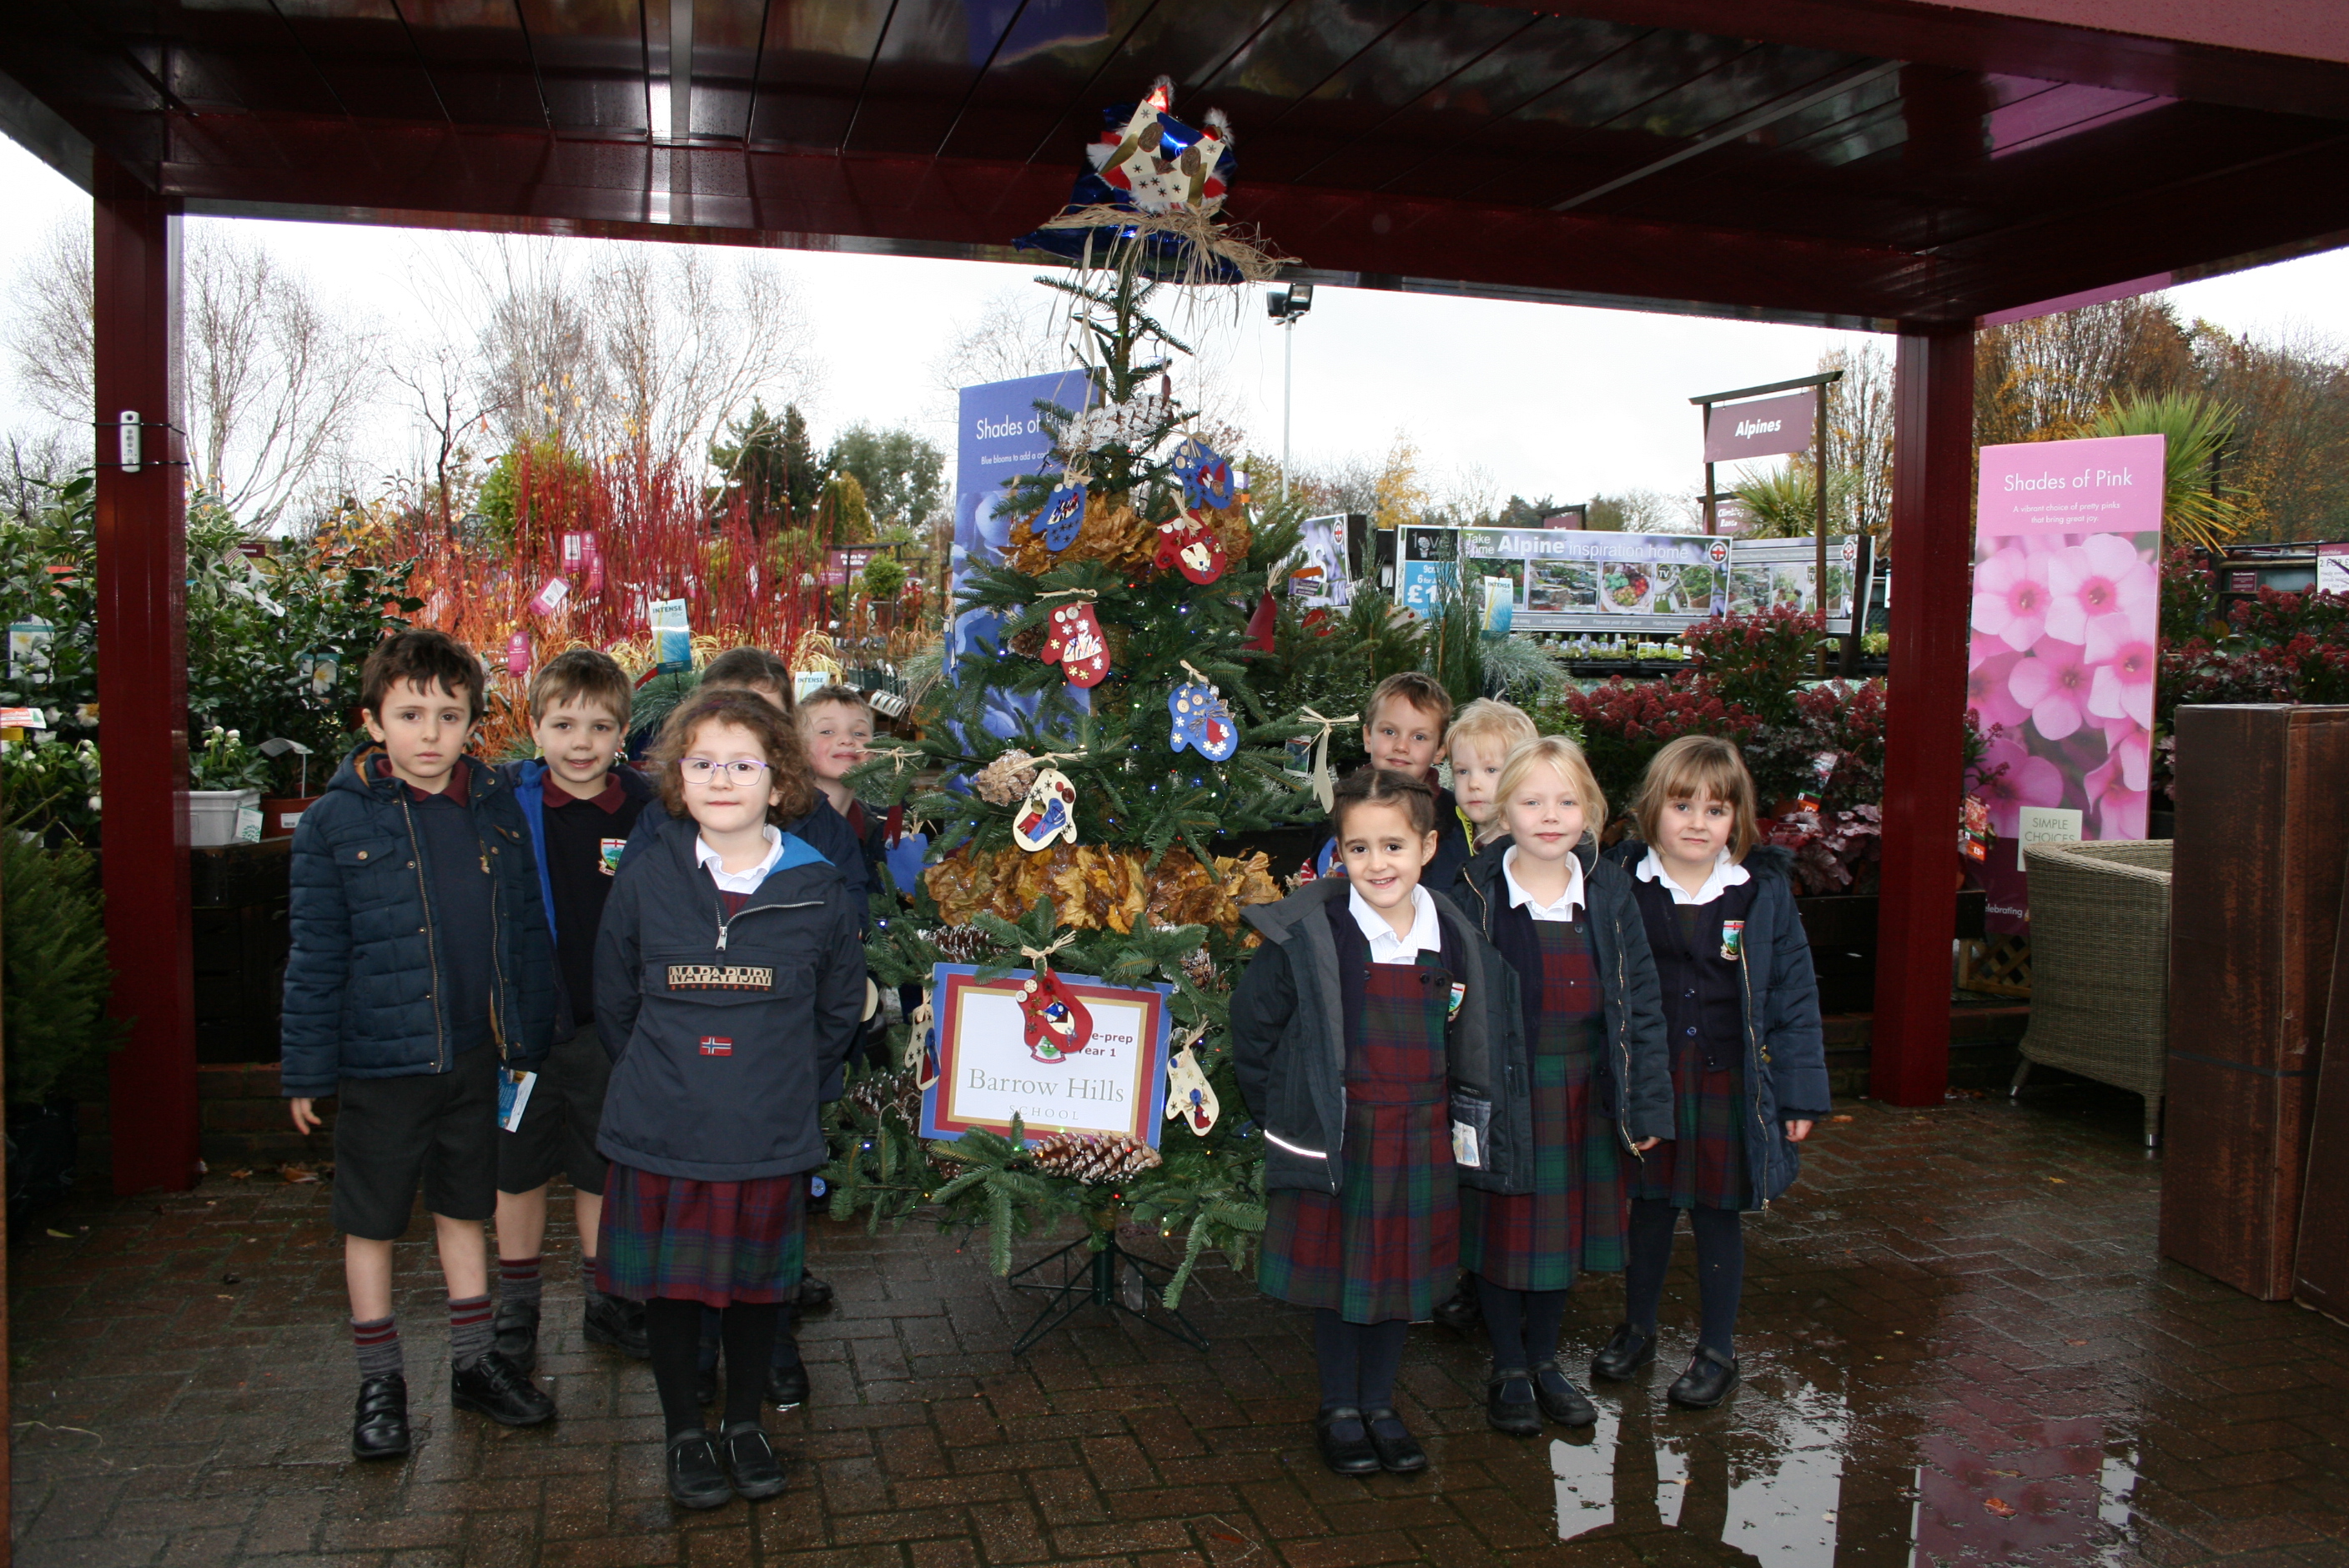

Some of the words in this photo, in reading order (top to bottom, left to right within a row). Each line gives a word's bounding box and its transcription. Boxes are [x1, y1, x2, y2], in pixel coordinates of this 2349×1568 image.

[976, 415, 1023, 440] Shades
[1027, 413, 1041, 434] of
[1734, 419, 1782, 440] Alpines
[981, 456, 992, 465] Blue
[993, 455, 1012, 464] blooms
[1013, 454, 1019, 462] to
[1019, 451, 1031, 460] add
[2004, 471, 2065, 492] Shades
[2072, 469, 2090, 488] of
[2096, 467, 2133, 487] Pink
[2020, 504, 2044, 513] vibrant
[2045, 503, 2068, 512] choice
[2070, 502, 2078, 510] of
[2079, 502, 2099, 512] pretty
[2101, 501, 2120, 510] pinks
[2031, 515, 2044, 524] that
[2045, 515, 2064, 525] bring
[2066, 515, 2085, 525] great
[2086, 515, 2099, 524] joy.
[1497, 535, 1565, 556] Alpine
[1569, 542, 1643, 560] inspiration
[1648, 544, 1688, 559] home
[1417, 575, 1423, 584] 6
[1658, 570, 1670, 578] TV
[652, 605, 683, 615] INTENSE
[2032, 817, 2069, 831] SIMPLE
[2025, 832, 2075, 842] CHOICES
[670, 966, 772, 985] NAPAPIJRI
[1092, 1033, 1134, 1045] e-prep
[1079, 1047, 1105, 1057] ear
[1109, 1048, 1116, 1058] 1
[967, 1068, 1059, 1097] Barrow
[1066, 1077, 1124, 1103] Hills
[1009, 1104, 1079, 1121] SCHOOL
